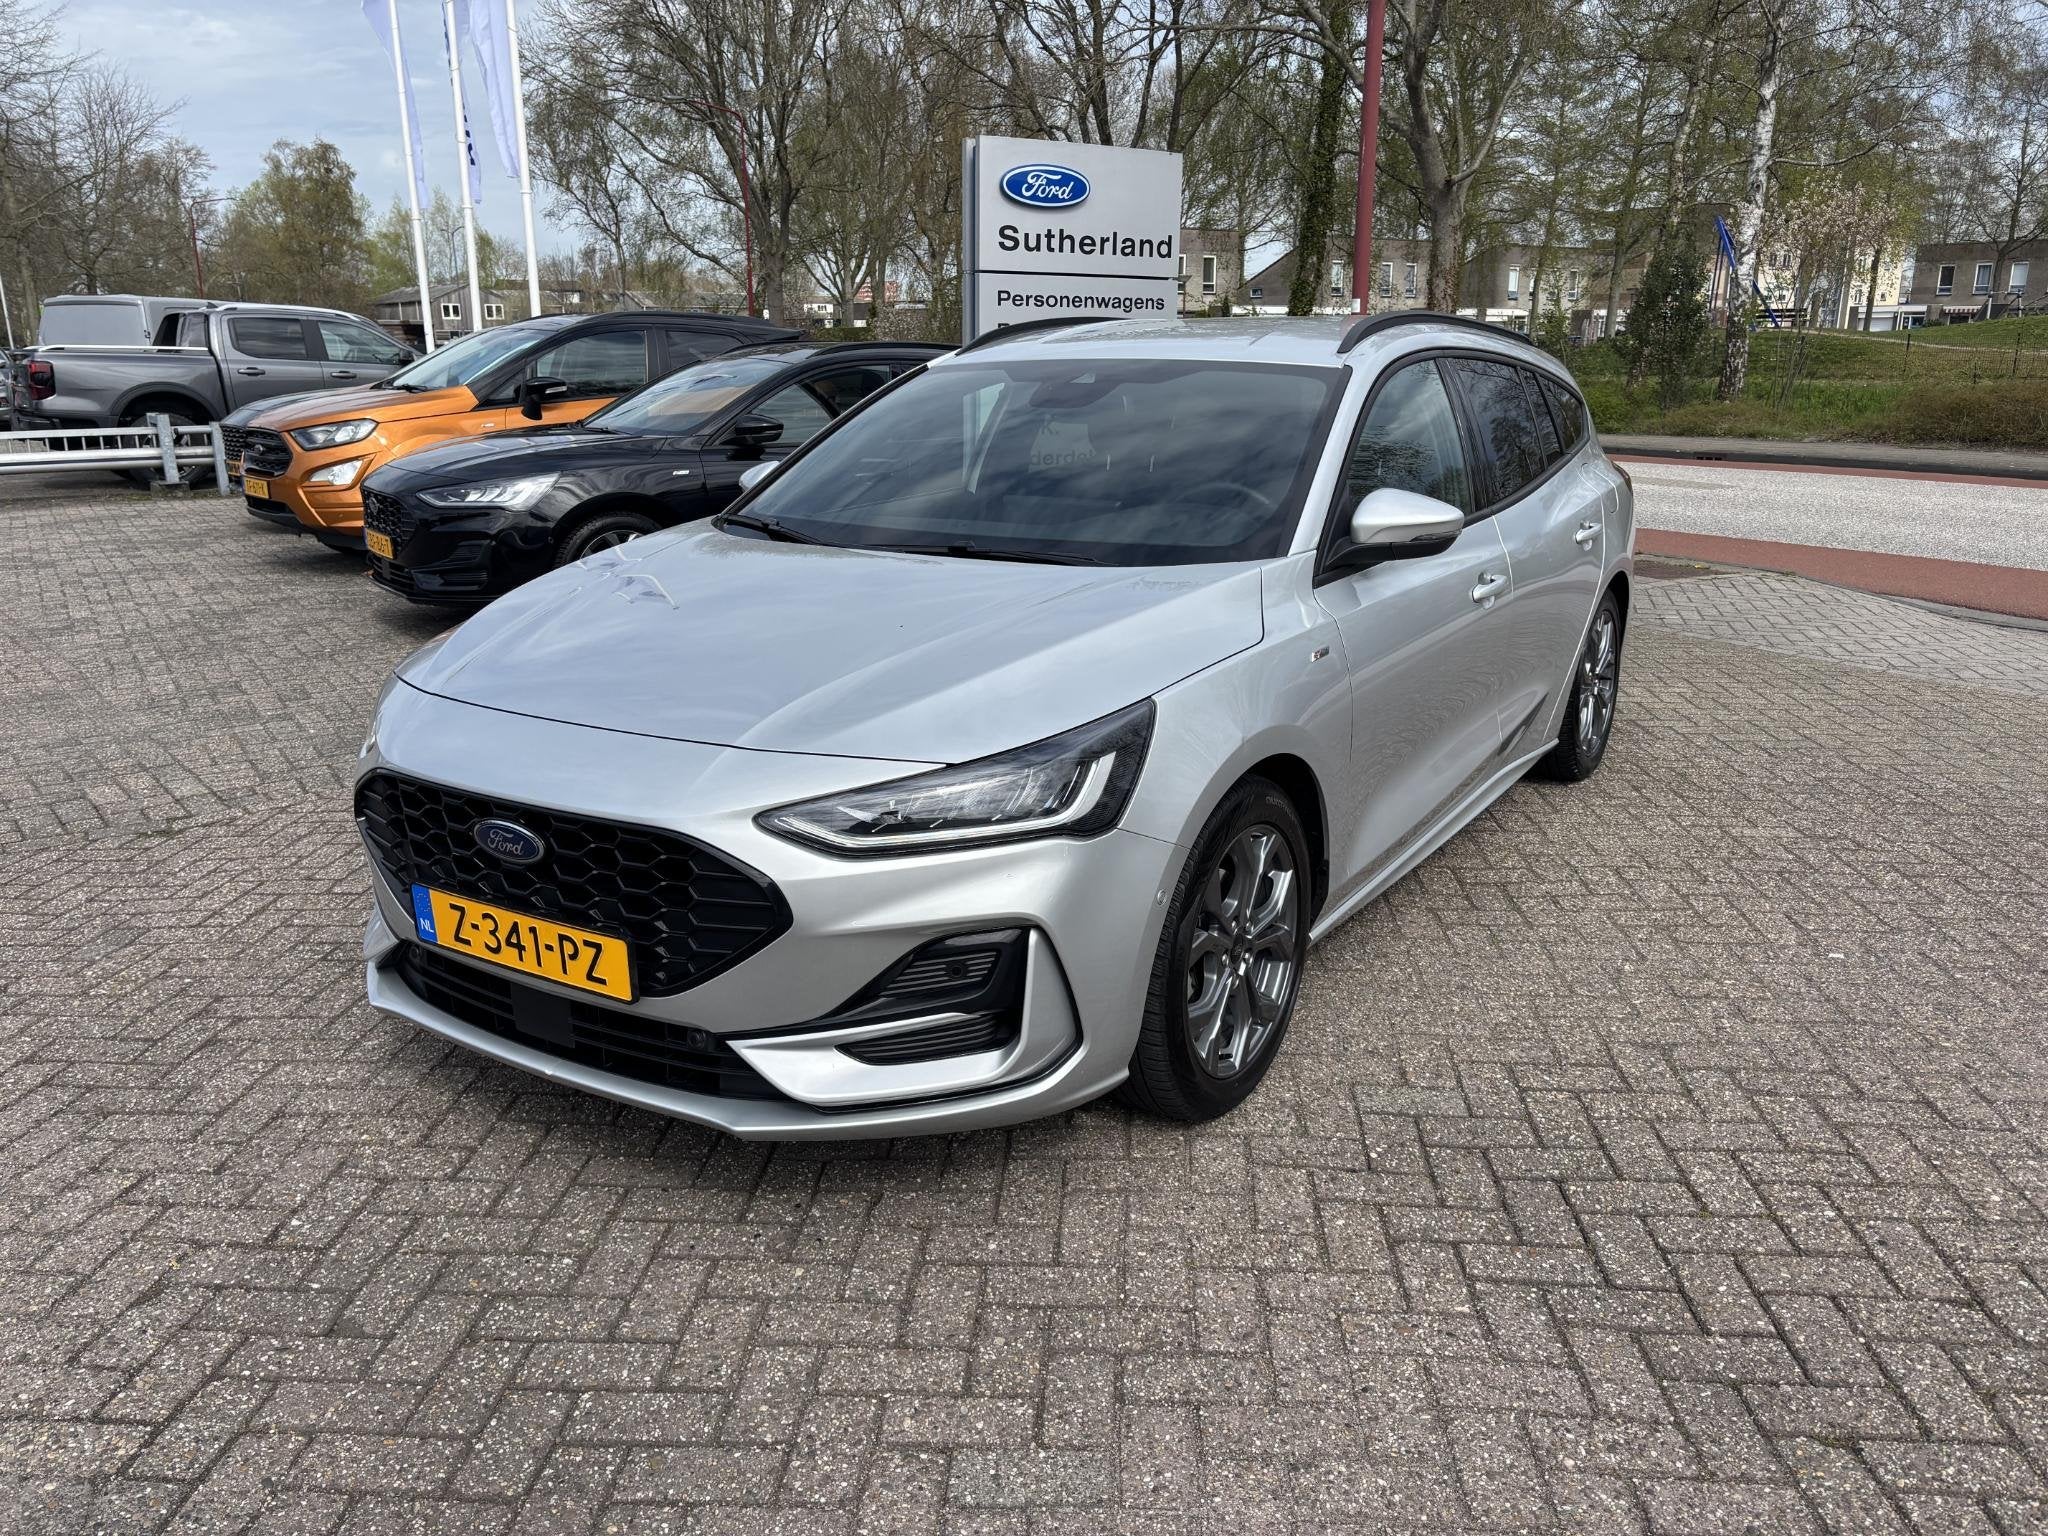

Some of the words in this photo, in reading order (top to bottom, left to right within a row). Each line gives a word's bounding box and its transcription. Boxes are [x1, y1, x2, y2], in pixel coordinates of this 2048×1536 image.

[1021, 171, 1074, 200] Ford
[998, 224, 1173, 259] Sutherland
[997, 290, 1165, 313] Personenwagens
[487, 829, 525, 857] Ford
[420, 919, 435, 934] NL
[449, 902, 608, 987] Z-341-PZ
